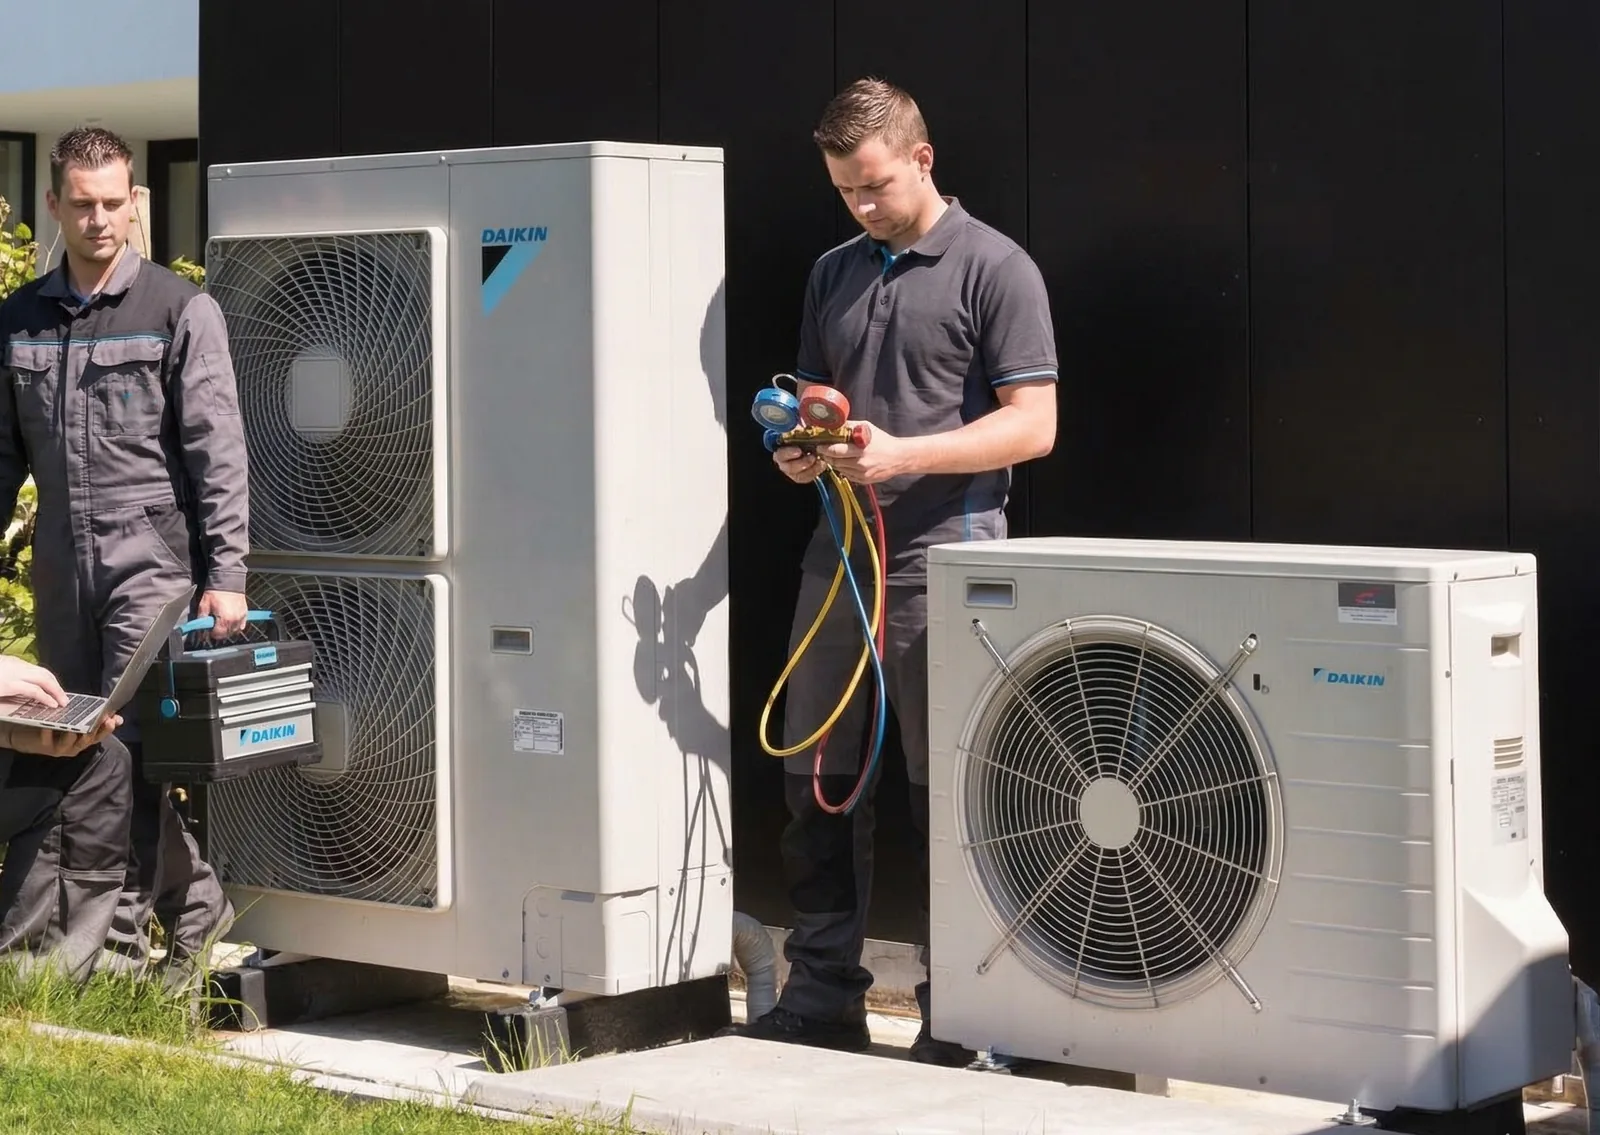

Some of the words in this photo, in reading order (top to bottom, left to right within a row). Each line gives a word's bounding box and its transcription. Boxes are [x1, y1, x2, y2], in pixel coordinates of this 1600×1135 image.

[481, 226, 548, 244] DAIKIN
[1327, 672, 1385, 686] DAIKIN
[251, 724, 296, 743] DAIKIN
